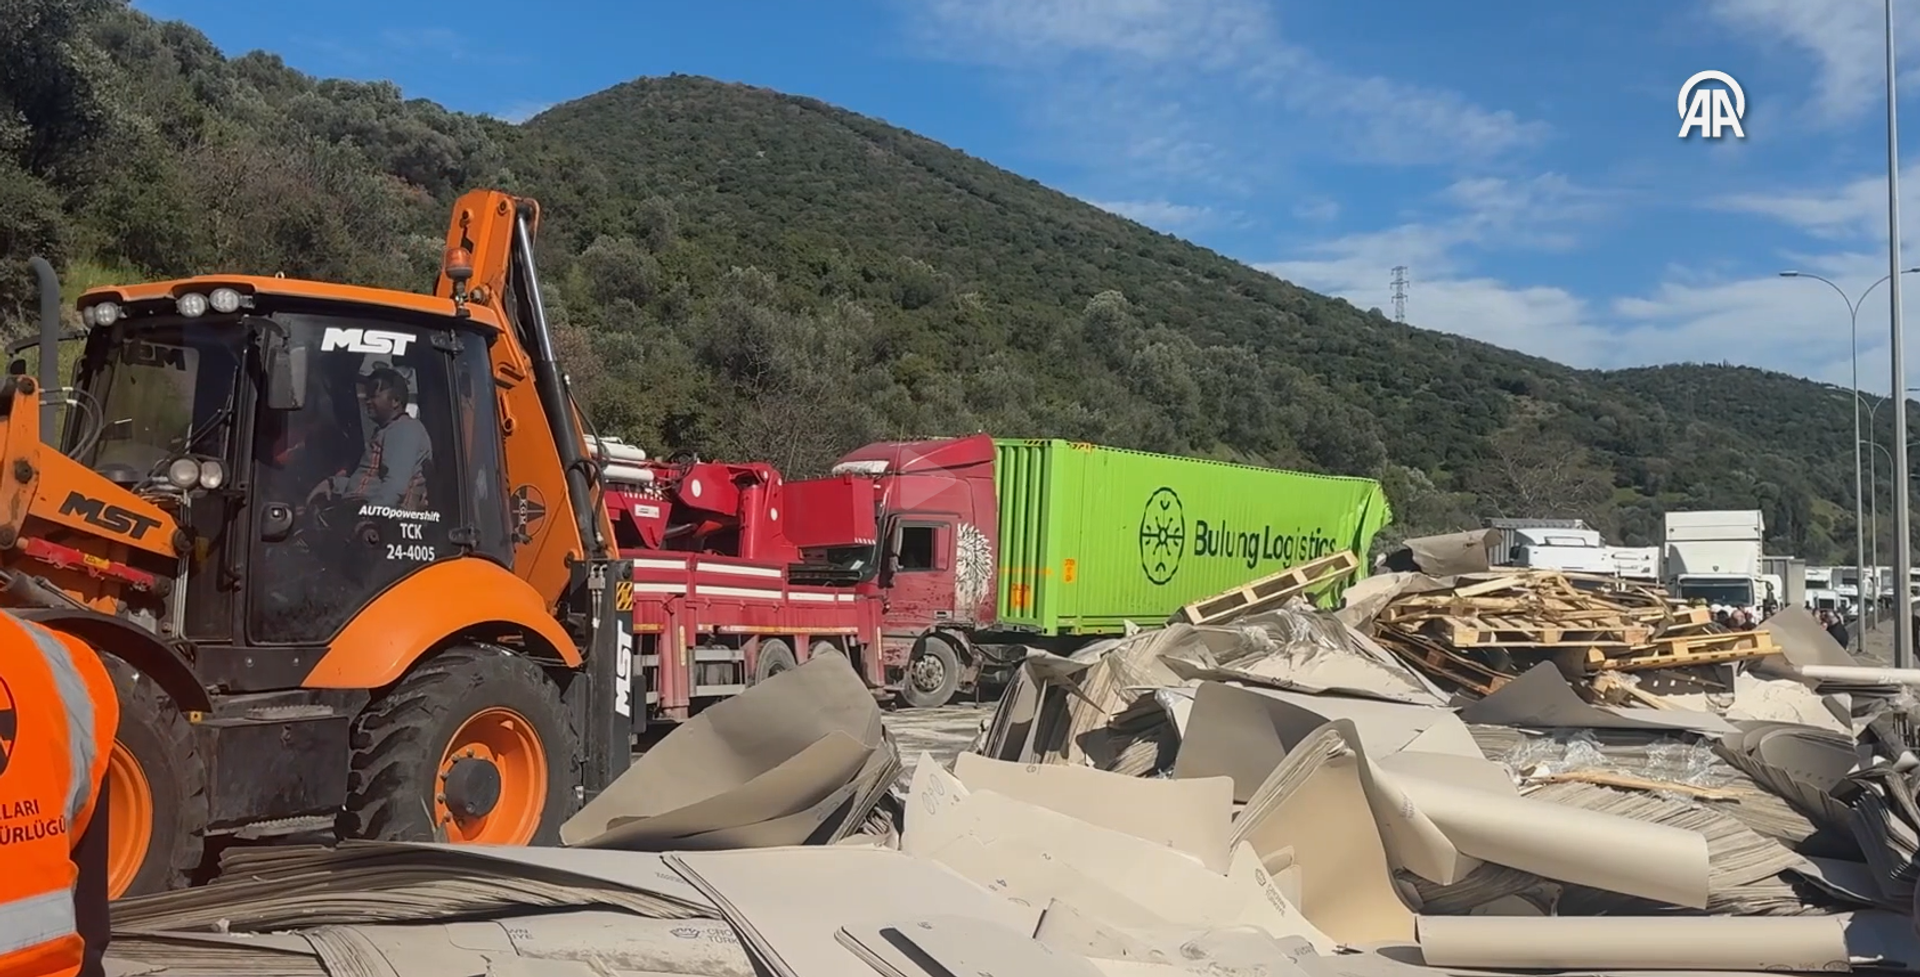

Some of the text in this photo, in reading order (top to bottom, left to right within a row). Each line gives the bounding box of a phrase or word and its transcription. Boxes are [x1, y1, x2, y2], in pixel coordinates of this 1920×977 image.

[321, 327, 417, 356] MST
[58, 490, 162, 540] MST
[358, 505, 441, 522] AUTOpowershift
[400, 523, 423, 540] TCK
[1194, 519, 1337, 569] Bulung Logistics
[386, 543, 436, 561] 24-4005
[615, 619, 633, 717] MST
[0, 799, 40, 820] LARI
